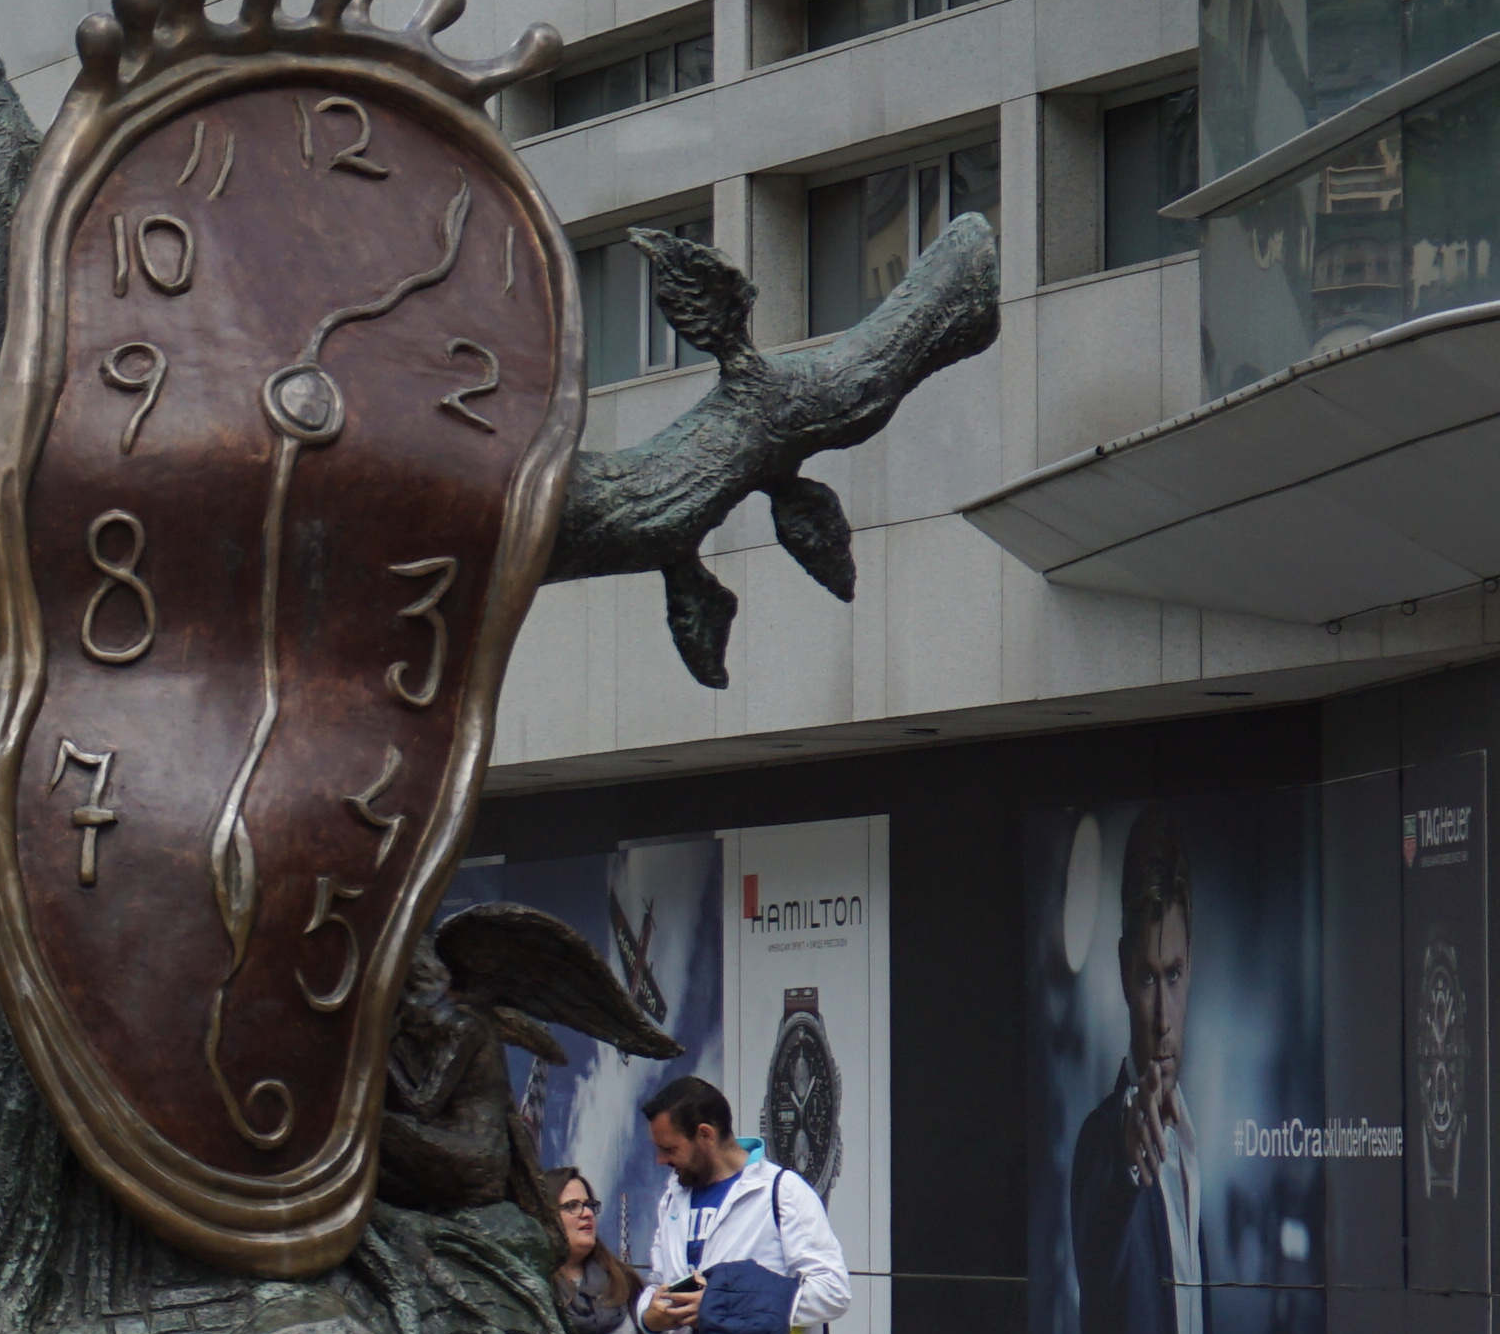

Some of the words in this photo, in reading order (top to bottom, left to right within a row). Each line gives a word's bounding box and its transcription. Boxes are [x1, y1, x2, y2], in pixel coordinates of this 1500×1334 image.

[179, 120, 237, 201] 11
[296, 96, 390, 183] 12
[111, 212, 196, 299] 10
[499, 222, 516, 298] 1
[100, 340, 169, 453] 9
[436, 336, 503, 433] 2
[80, 508, 157, 663] 8
[384, 555, 458, 709] 3
[47, 738, 119, 887] 7
[296, 877, 361, 1012] 5
[751, 895, 863, 934] HAMILTON
[1233, 1117, 1404, 1158] #DontCrackUnderPressure
